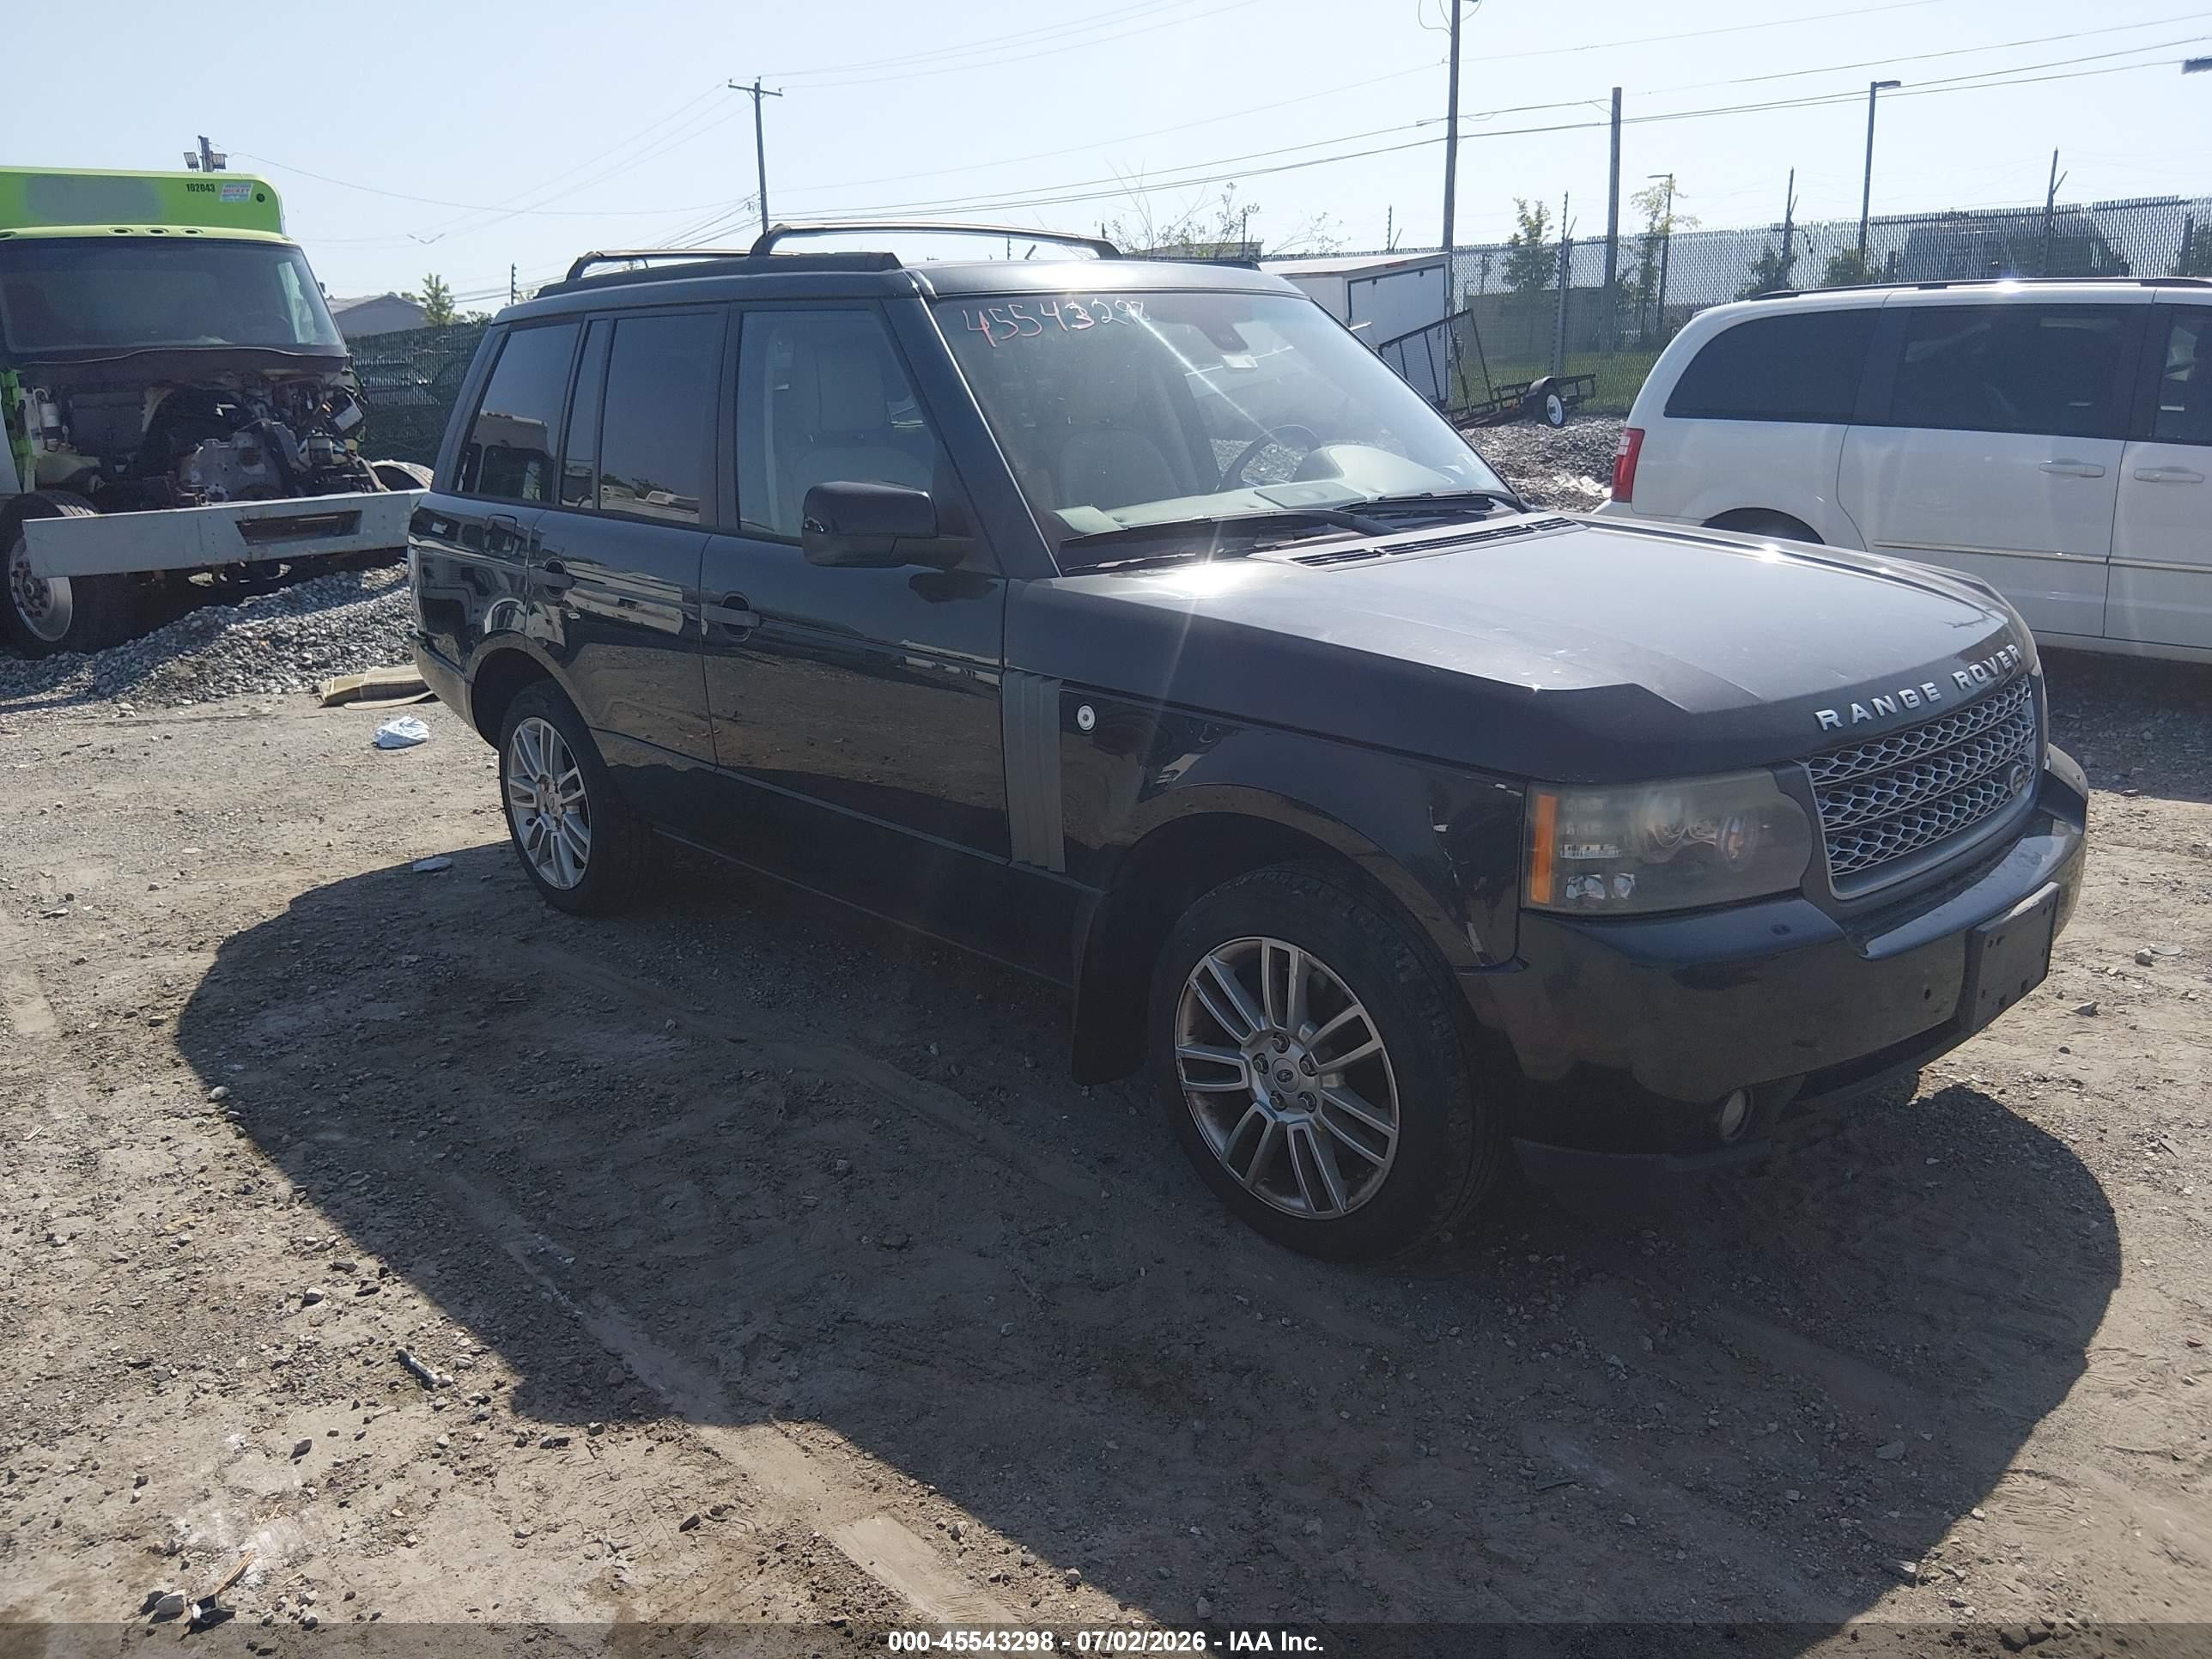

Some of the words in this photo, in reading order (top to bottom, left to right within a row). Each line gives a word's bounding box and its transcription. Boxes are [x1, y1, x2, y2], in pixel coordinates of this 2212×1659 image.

[185, 183, 216, 193] 102043
[1814, 682, 1942, 731] RANGE
[1951, 643, 2021, 690] ROVER
